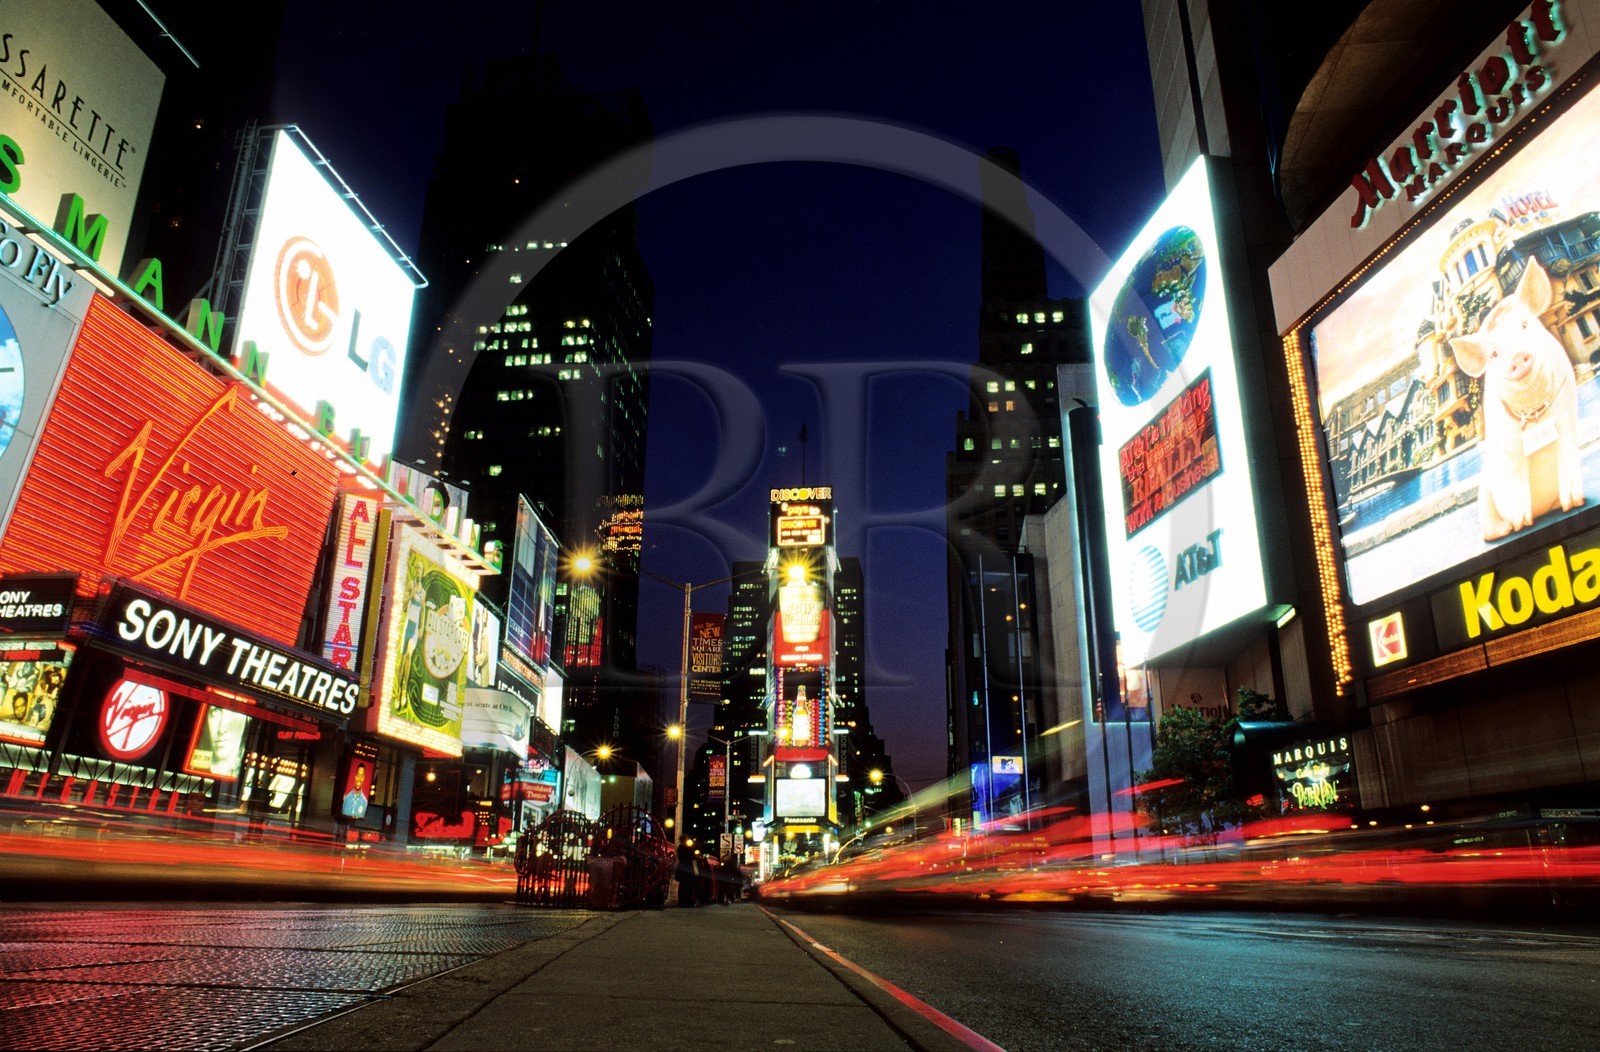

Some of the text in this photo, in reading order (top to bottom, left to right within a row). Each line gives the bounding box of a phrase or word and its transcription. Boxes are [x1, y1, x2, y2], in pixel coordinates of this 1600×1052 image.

[1351, 0, 1562, 228] Marriott
[1405, 65, 1548, 202] MARQUIS
[72, 140, 120, 189] LINGERIE
[347, 308, 397, 396] LG
[105, 385, 288, 599] Virgin
[770, 487, 832, 501] DISCOVER
[1132, 425, 1205, 507] REALLY
[344, 500, 370, 569] ALL
[1174, 527, 1224, 592] AT&T
[118, 598, 360, 715] SONY THEATRES
[691, 645, 723, 653] SQUARE
[691, 652, 723, 667] VISITORS
[692, 637, 723, 647] TIMES
[699, 626, 720, 639] NEW
[691, 665, 722, 673] CENTER
[106, 681, 164, 750] Virgin
[1273, 737, 1348, 765] MARQUIS
